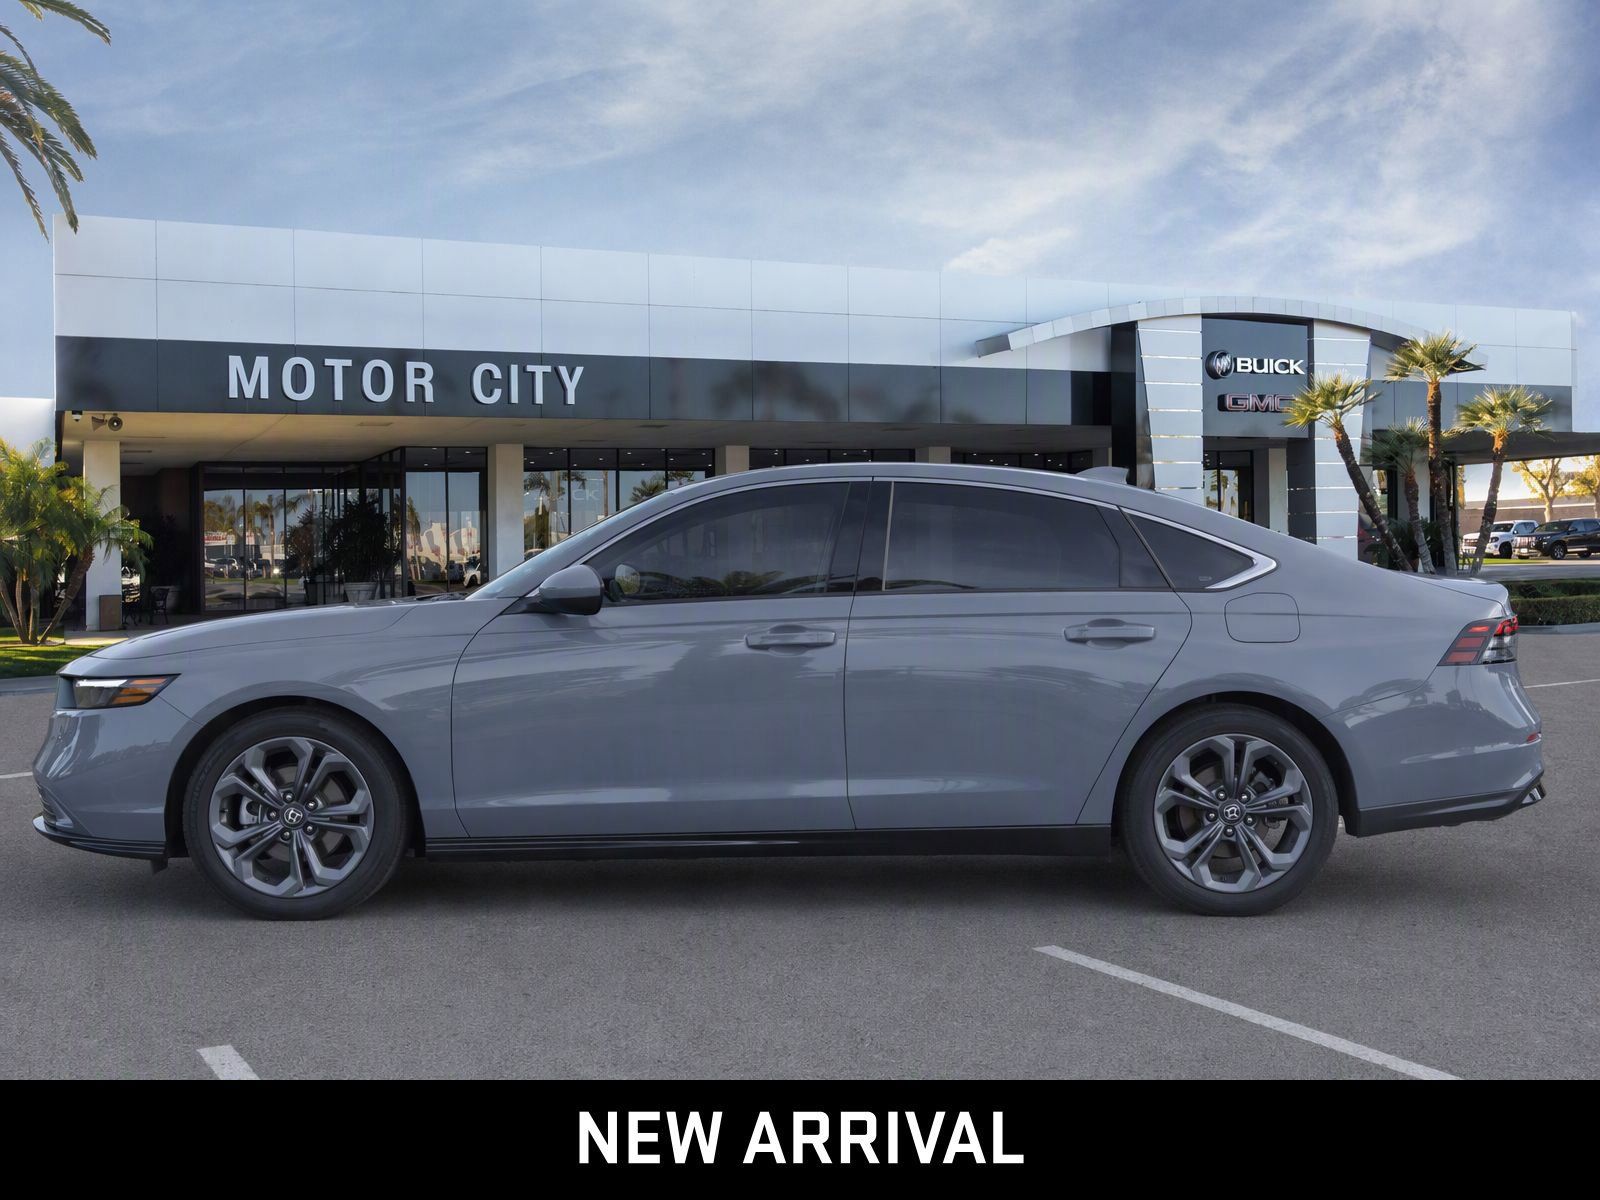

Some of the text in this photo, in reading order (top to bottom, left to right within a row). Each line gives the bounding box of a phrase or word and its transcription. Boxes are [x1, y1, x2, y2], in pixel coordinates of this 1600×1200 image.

[227, 355, 585, 405] MOTOR CITY
[1236, 357, 1305, 375] BUICK
